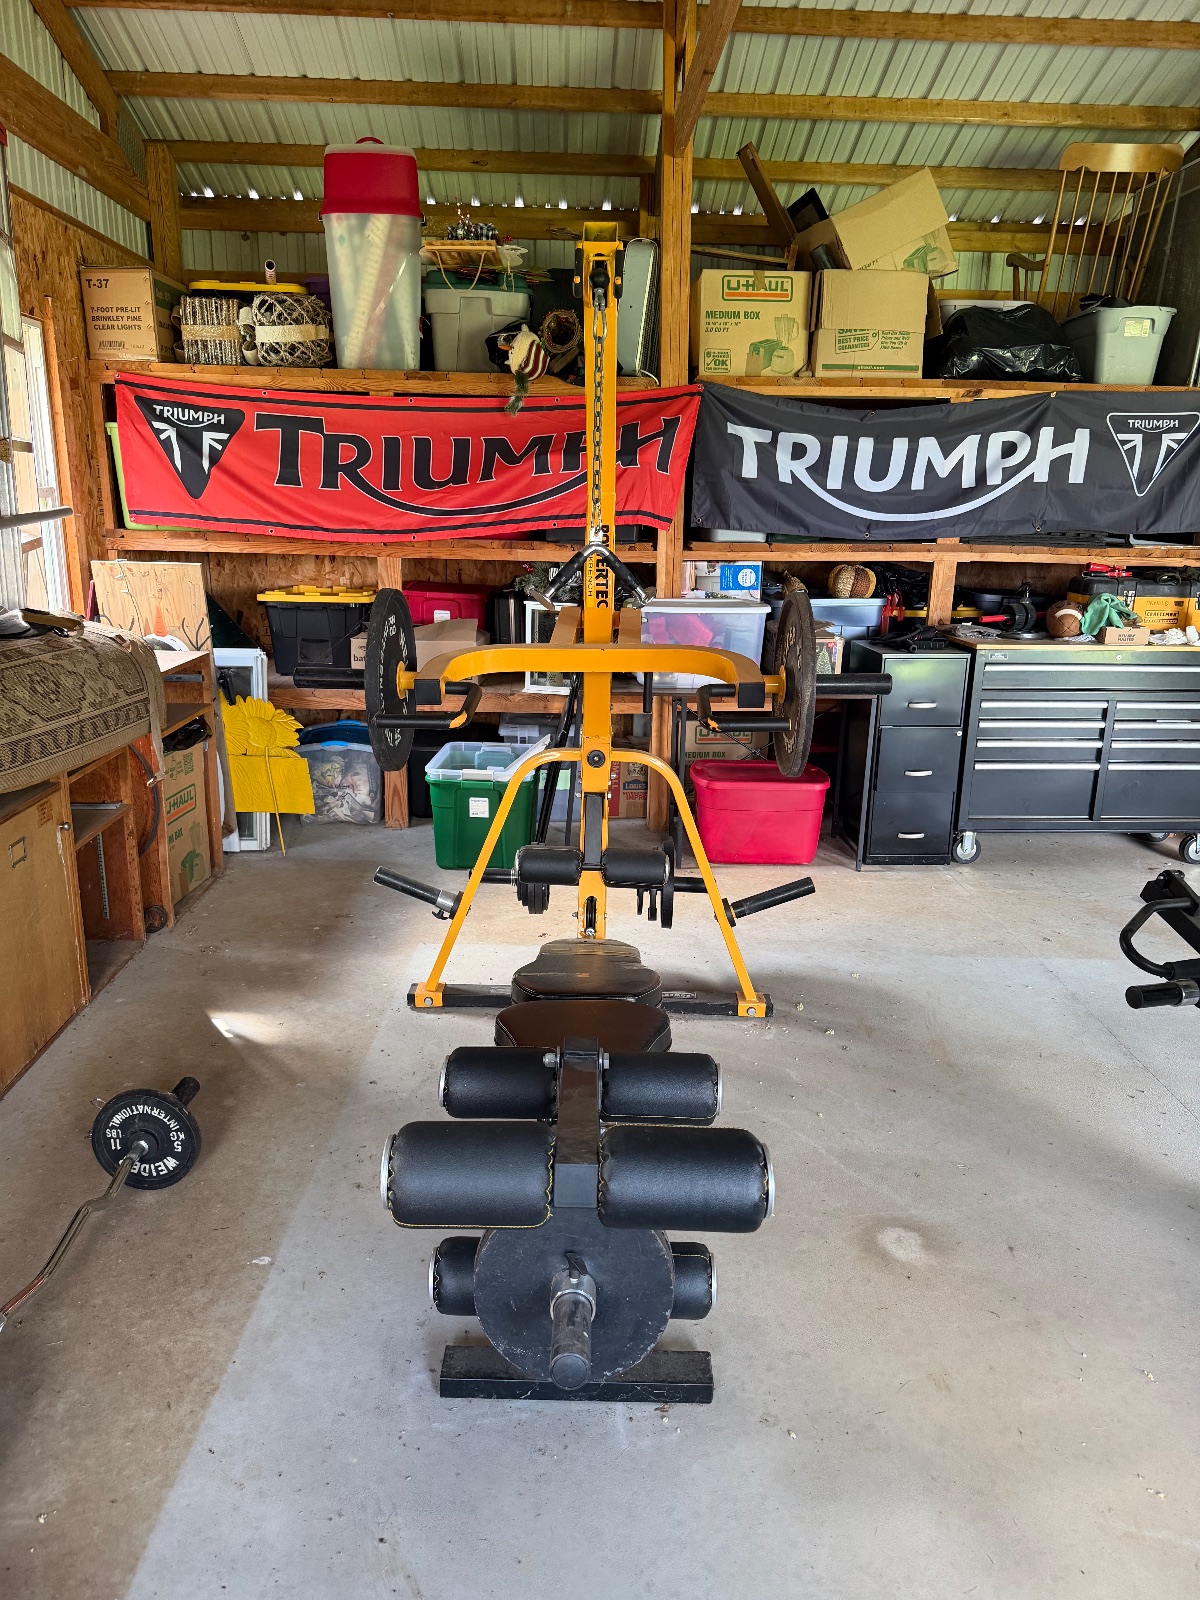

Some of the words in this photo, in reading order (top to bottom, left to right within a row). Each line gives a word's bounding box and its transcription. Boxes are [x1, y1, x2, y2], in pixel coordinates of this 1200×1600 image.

[86, 279, 109, 288] T-37
[705, 311, 740, 319] MEDIUM
[744, 311, 760, 320] BOX
[853, 335, 869, 343] PRICE
[153, 405, 225, 427] TRIUMPH
[1128, 420, 1179, 432] TRIUMPH
[727, 422, 1090, 522] TRIUMPH
[109, 1105, 180, 1131] INTERNATIONAL
[106, 1128, 122, 1138] LBS
[170, 1131, 185, 1141] KG
[110, 1139, 121, 1151] 11
[174, 1141, 182, 1152] 5
[119, 1156, 179, 1176] WEIDE
